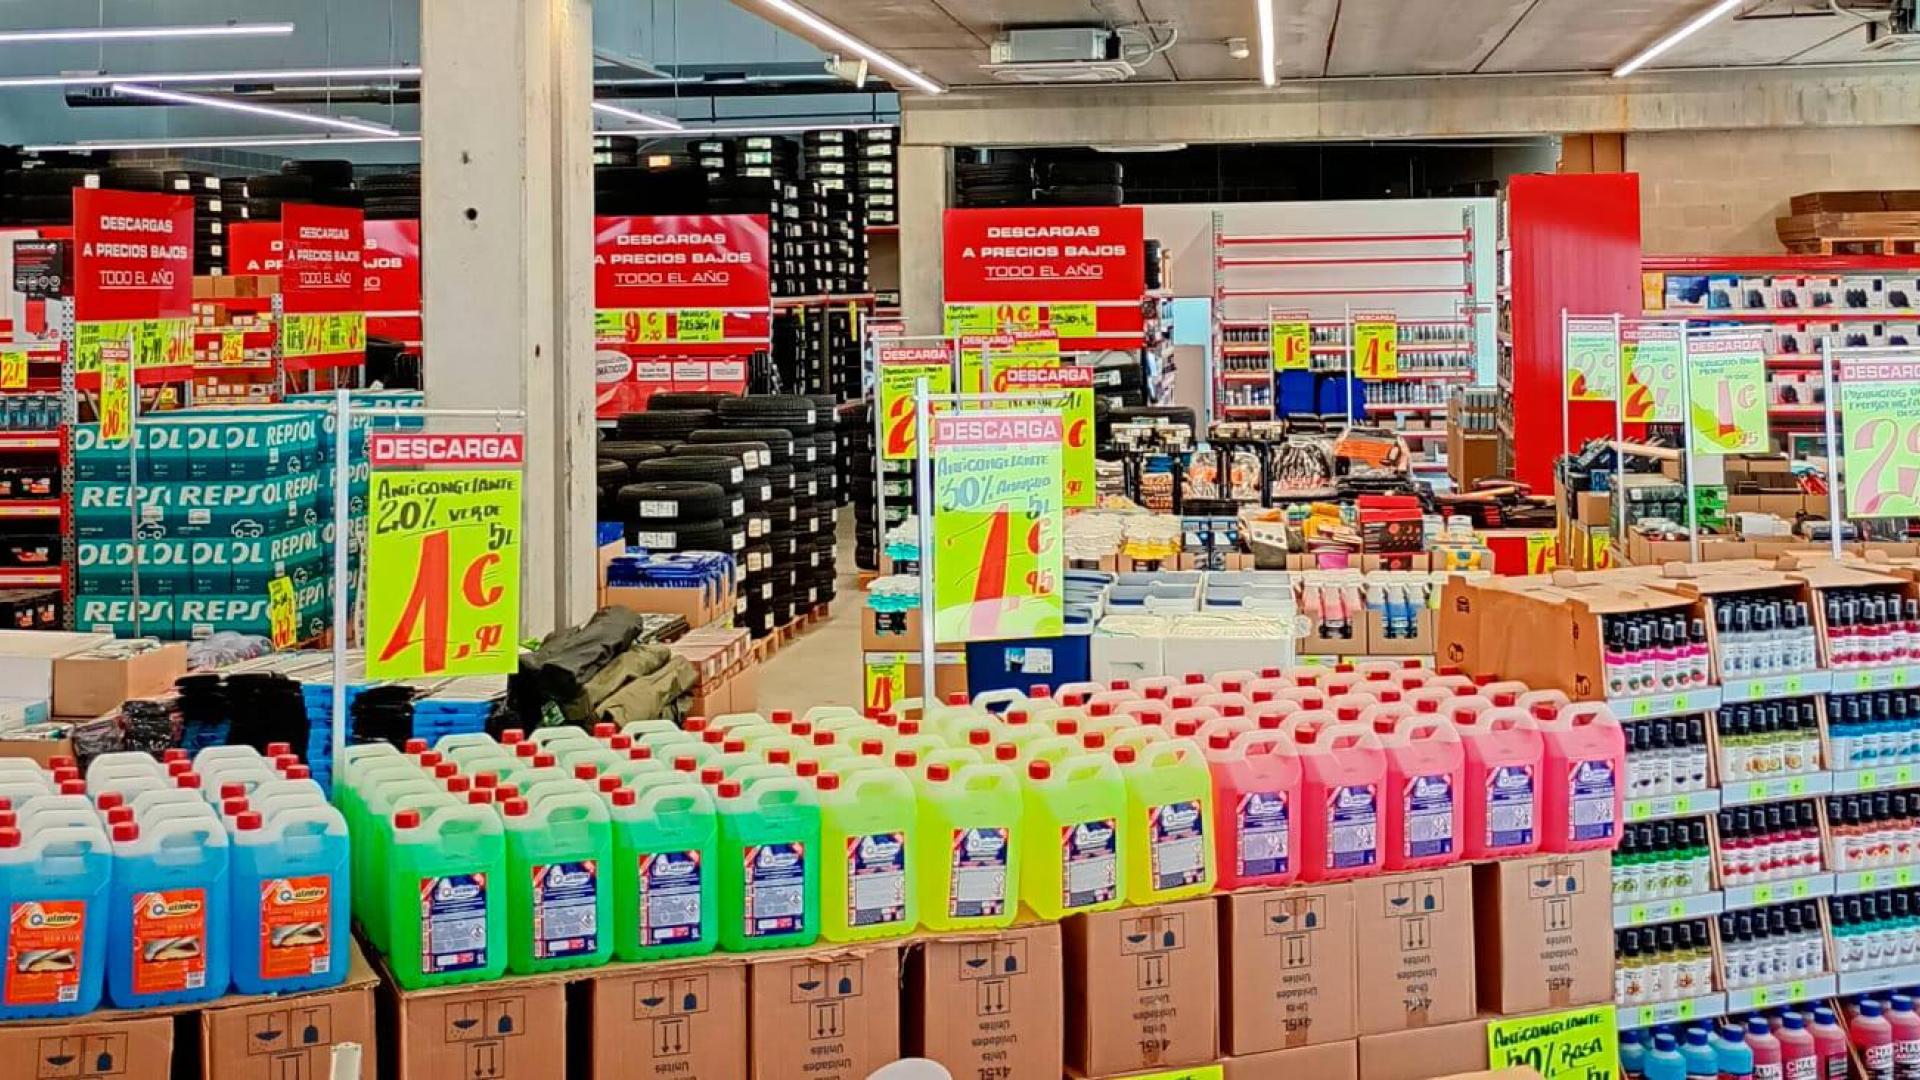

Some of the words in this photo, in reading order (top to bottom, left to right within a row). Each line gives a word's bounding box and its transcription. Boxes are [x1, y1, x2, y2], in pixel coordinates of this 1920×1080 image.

[101, 216, 172, 233] DESCARGAS
[300, 227, 349, 239] DESCARGAS
[988, 227, 1099, 238] DESCARGAS
[617, 233, 726, 246] DESCARGAS
[83, 243, 93, 257] A
[97, 244, 148, 258] PRECIOS
[150, 245, 187, 258] BAJOS
[288, 250, 296, 262] A
[297, 250, 333, 262] PRECIOS
[334, 251, 361, 262] BAJOS
[962, 248, 976, 258] A
[981, 247, 1058, 258] PRECIOS
[1064, 246, 1126, 257] BAJOS
[611, 253, 686, 265] PRECIOS
[692, 252, 752, 264] BAJOS
[100, 271, 132, 286] TODO
[135, 270, 148, 285] EL
[150, 267, 174, 285] AÑO
[985, 266, 1034, 277] TODO
[1040, 266, 1060, 277] EL
[1065, 263, 1104, 277] AÑO
[300, 272, 321, 284] TODO
[324, 272, 333, 284] EL
[335, 270, 351, 284] AÑO
[614, 273, 662, 285] TODO
[668, 273, 686, 284] EL
[692, 270, 729, 284] AÑO
[882, 349, 949, 361] DESCARGA
[1007, 369, 1090, 382] DESCARGA
[267, 419, 316, 447] REPSOL
[939, 420, 1058, 441] DESCARGA
[376, 439, 518, 460] DESCARGA
[376, 496, 438, 534] 20%
[449, 505, 502, 523] VERDE
[271, 530, 318, 561] REPSOL
[379, 530, 449, 674] 1
[1540, 948, 1578, 959] Unidades
[1397, 968, 1437, 979] Unidades
[1546, 978, 1574, 991] 4x5L
[1276, 987, 1317, 999] Unidades
[1133, 1008, 1176, 1020] Unidades
[1282, 1018, 1312, 1032] 4x5L
[971, 1034, 1017, 1047] Unidades
[982, 1051, 1006, 1062] Units
[803, 1058, 851, 1072] Unidades
